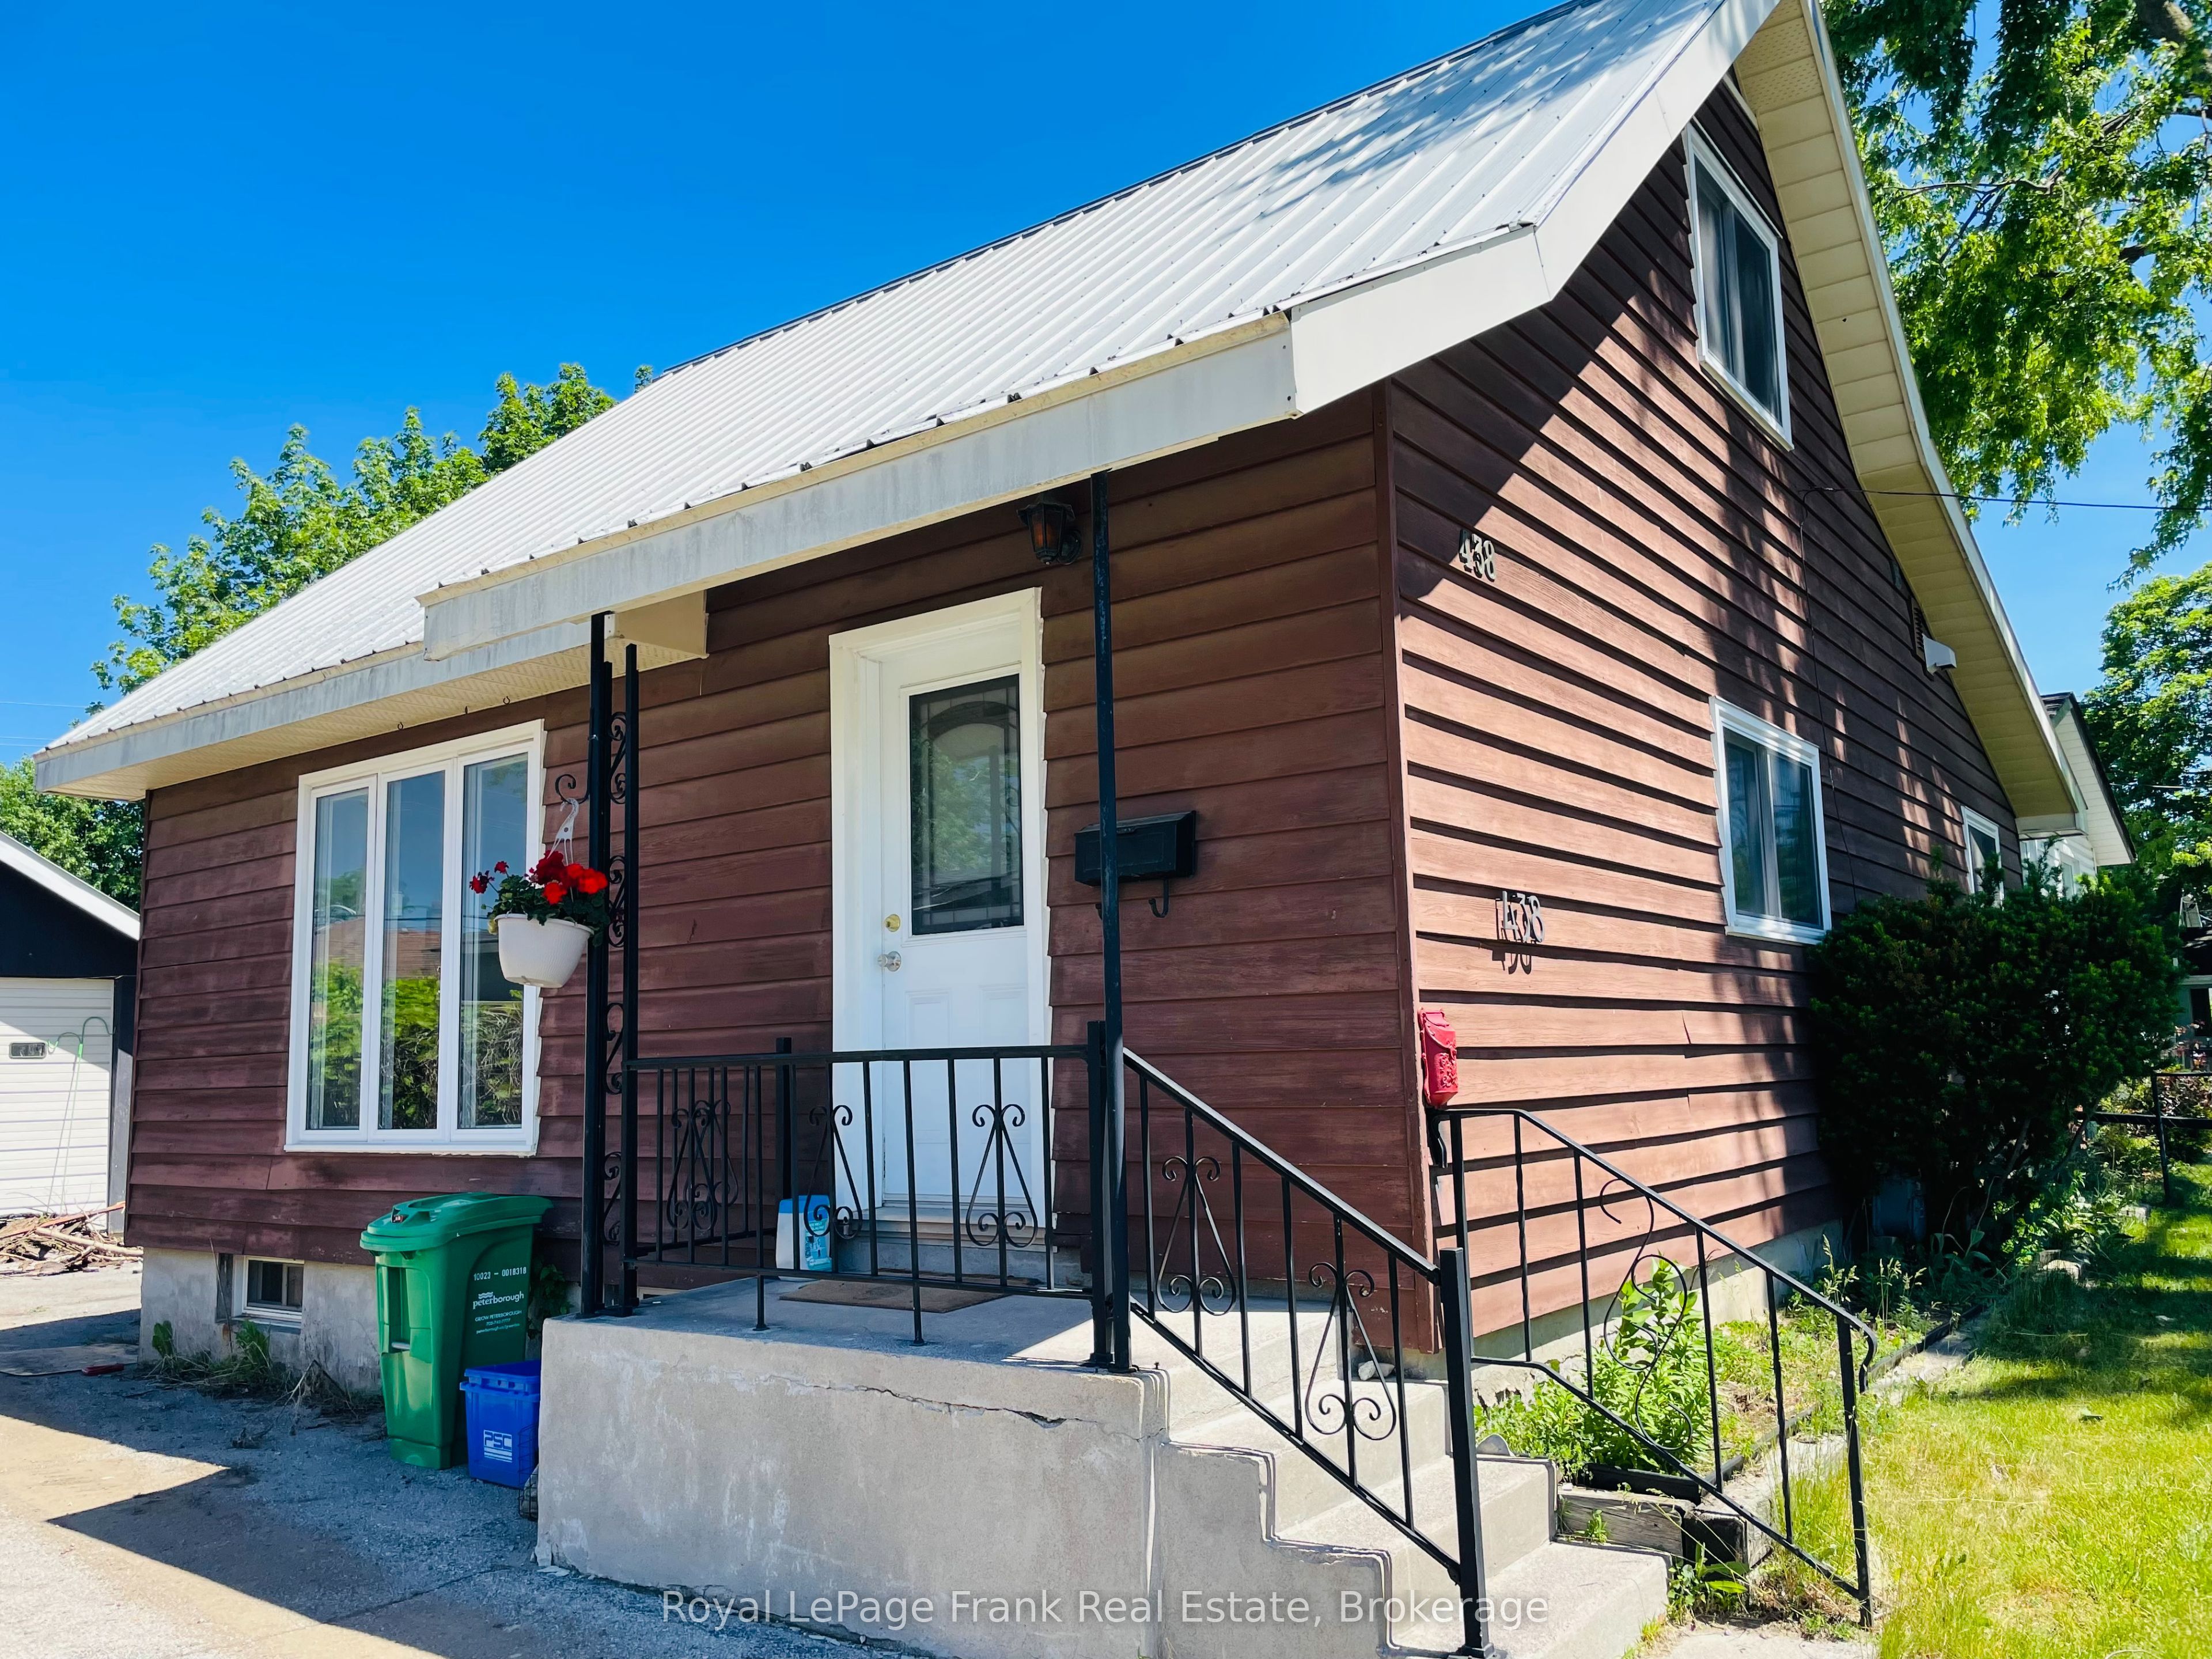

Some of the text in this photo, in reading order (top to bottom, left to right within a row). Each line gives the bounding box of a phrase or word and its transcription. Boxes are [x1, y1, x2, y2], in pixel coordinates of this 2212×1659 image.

[1459, 529, 1496, 581] 438
[1502, 891, 1545, 942] 438
[474, 1272, 491, 1281] 10023
[472, 1291, 524, 1309] peterborough
[484, 1431, 512, 1450] PSC
